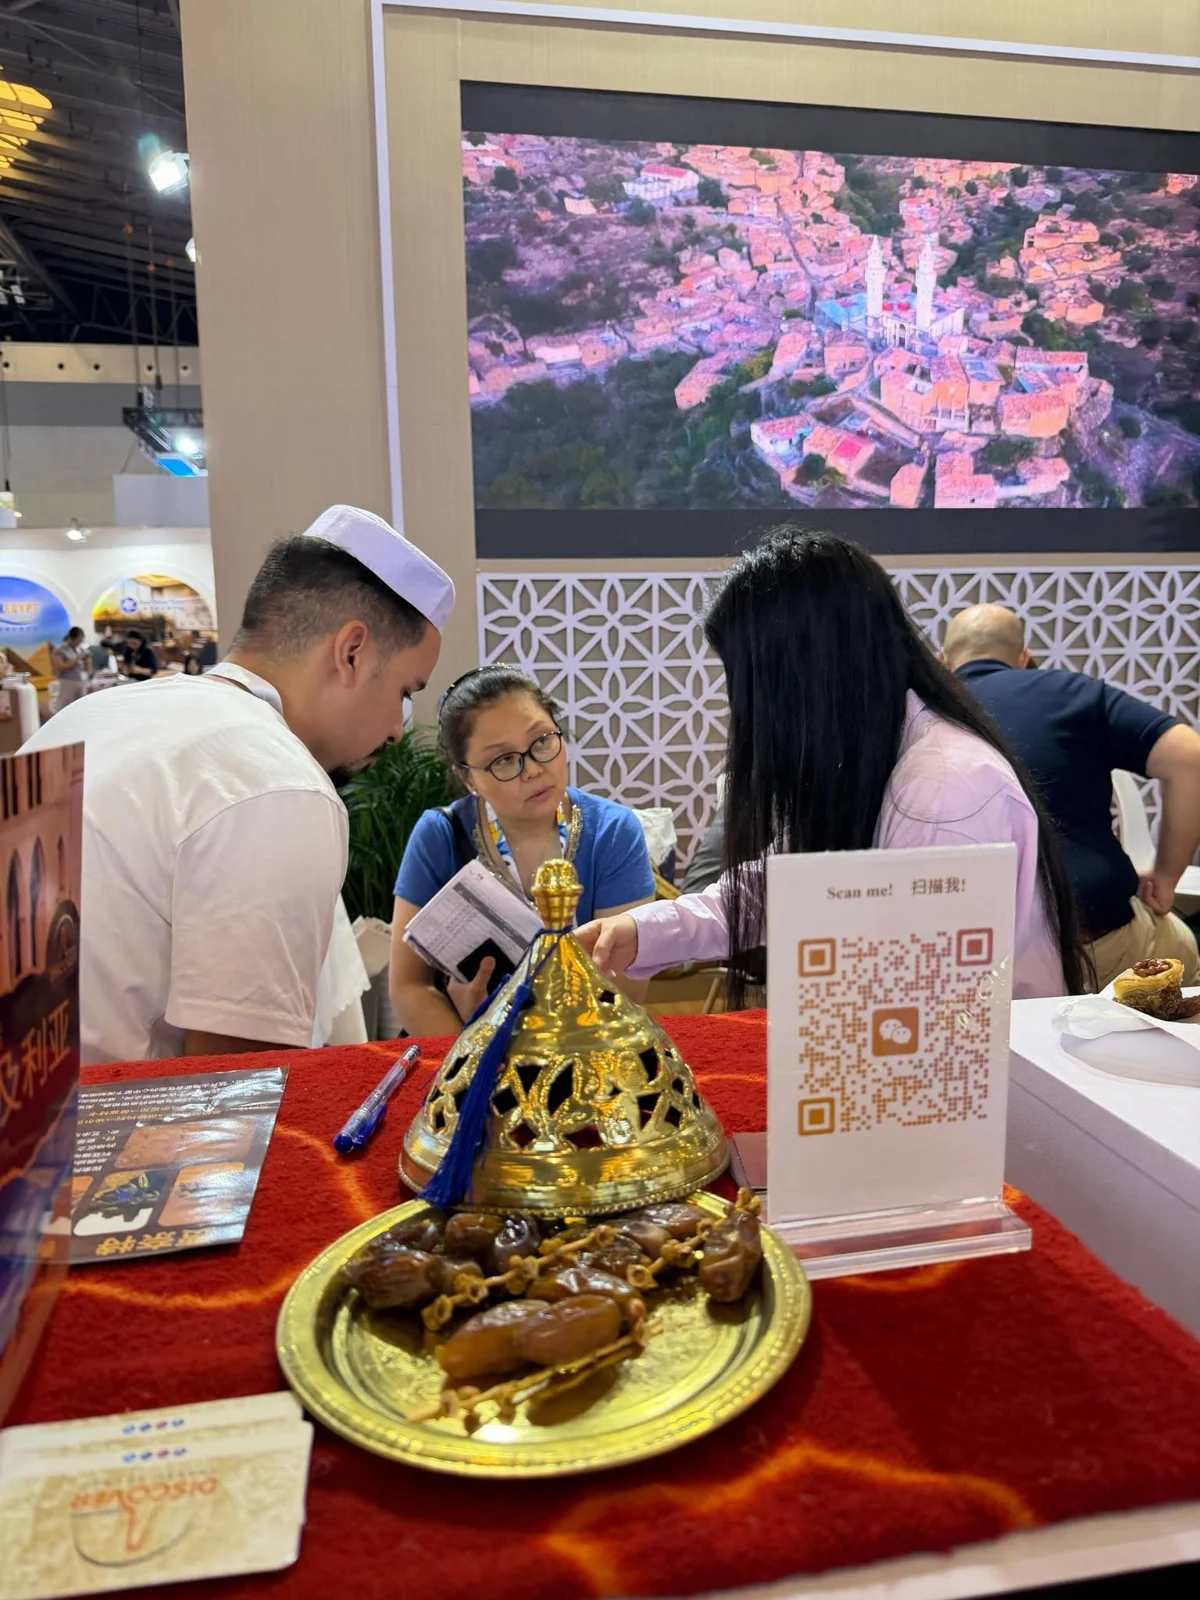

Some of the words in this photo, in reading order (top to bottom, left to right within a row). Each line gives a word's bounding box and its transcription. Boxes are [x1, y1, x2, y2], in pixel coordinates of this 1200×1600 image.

[826, 886, 862, 900] Scan
[866, 883, 893, 898] me!
[69, 1476, 218, 1509] DISCOVER
